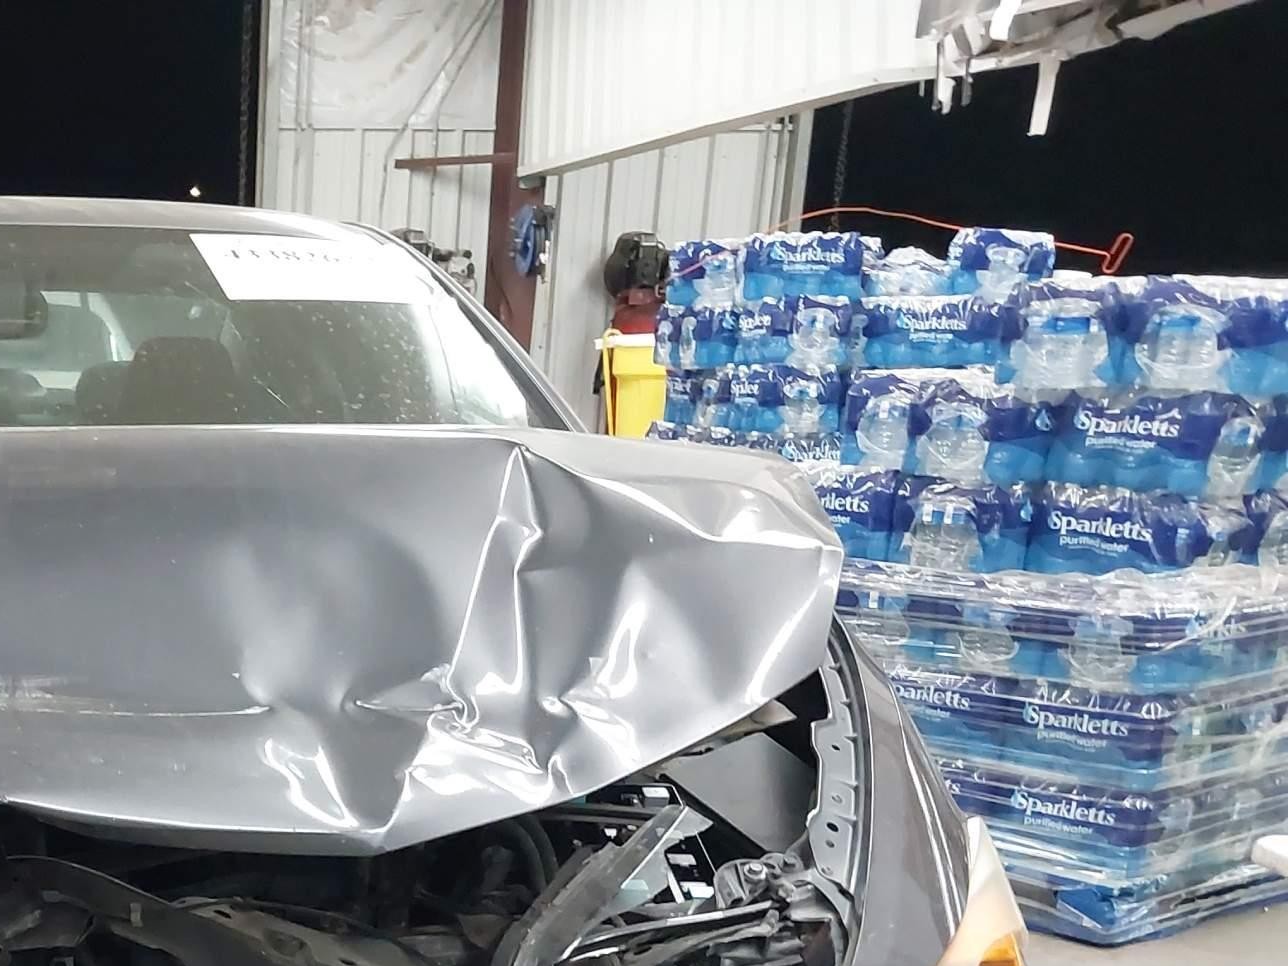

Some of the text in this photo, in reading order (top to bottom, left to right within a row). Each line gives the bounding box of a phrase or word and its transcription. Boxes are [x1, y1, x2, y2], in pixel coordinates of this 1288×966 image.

[1076, 409, 1180, 438] Sparkletts
[1025, 703, 1130, 738] Sparkletts
[1014, 790, 1116, 826] Sparkletts
